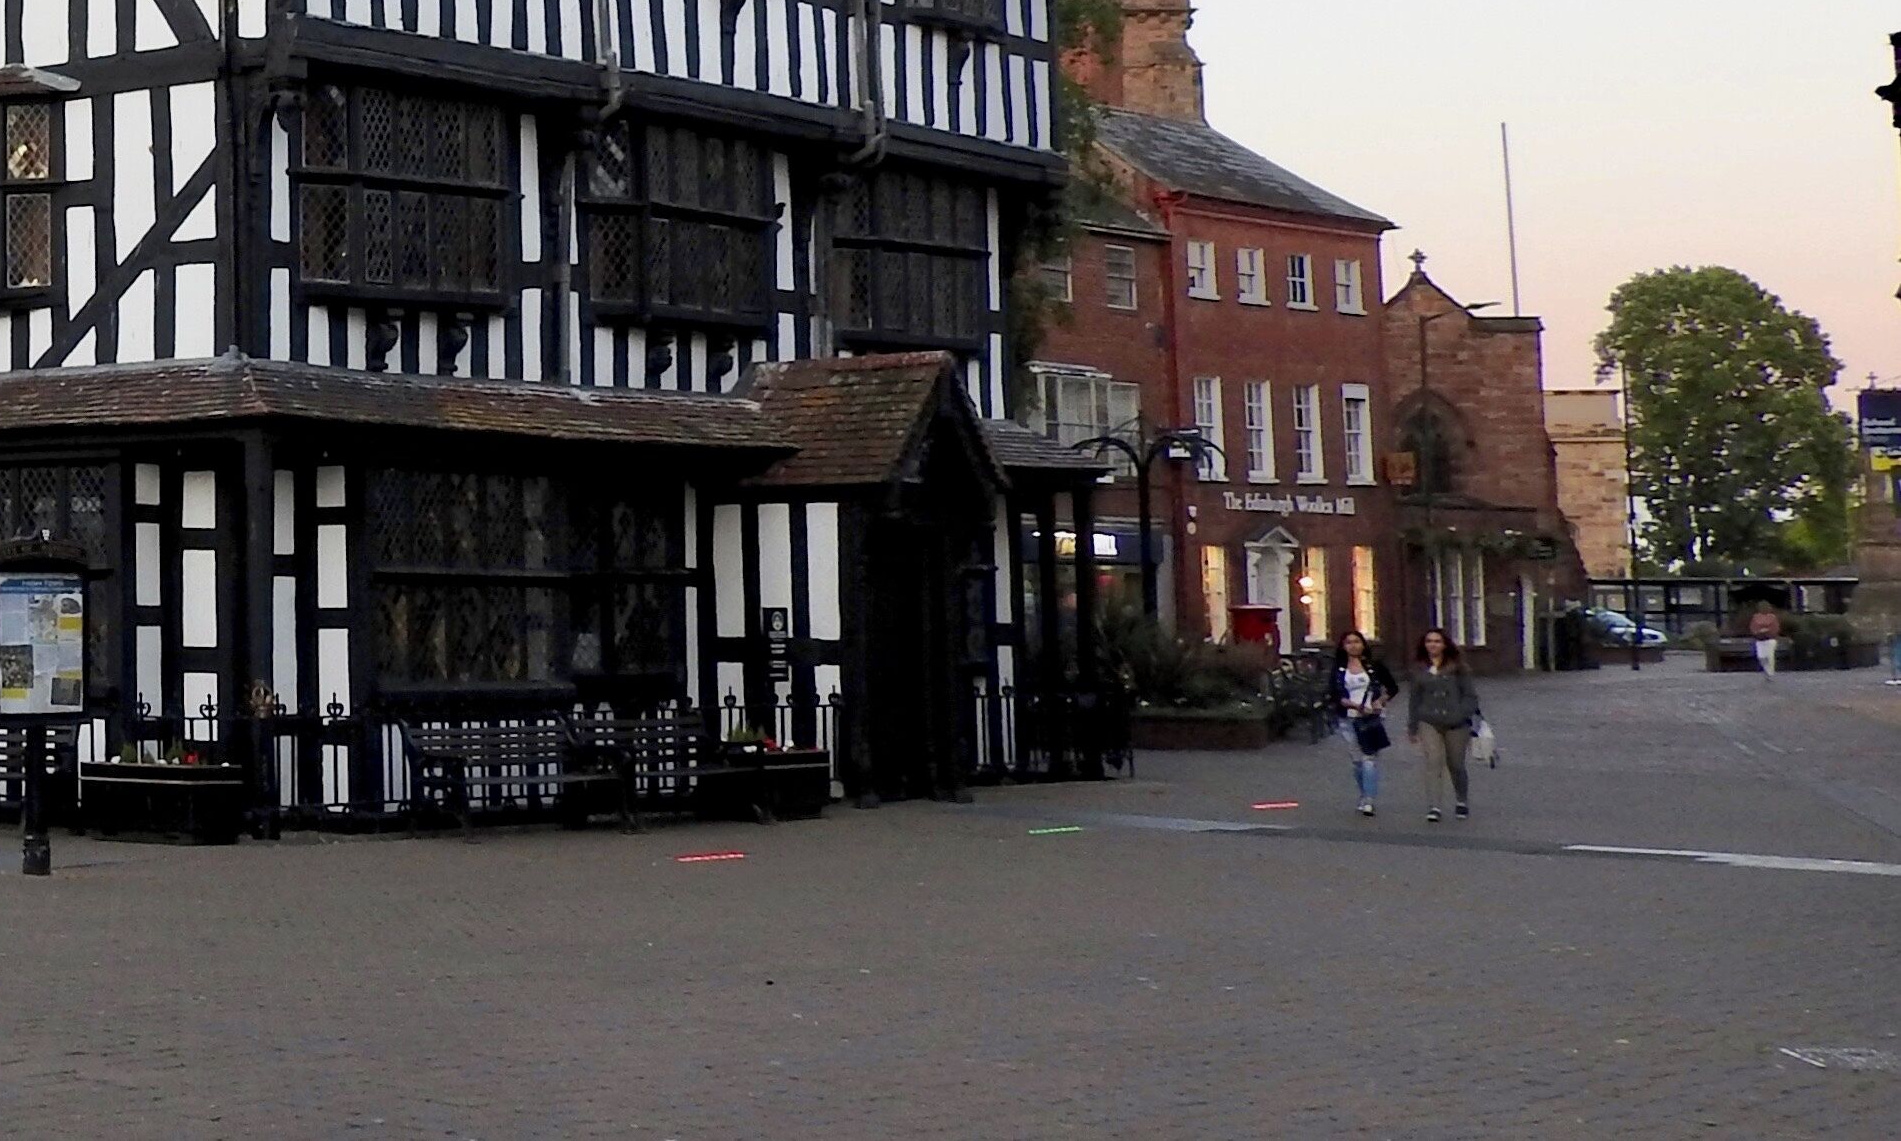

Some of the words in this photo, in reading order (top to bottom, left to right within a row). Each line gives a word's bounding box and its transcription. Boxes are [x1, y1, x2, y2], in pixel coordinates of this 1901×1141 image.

[1223, 491, 1242, 510] The
[1245, 492, 1294, 517] Edinburgh
[1296, 495, 1333, 514] Woollen
[1336, 497, 1355, 515] Mill
